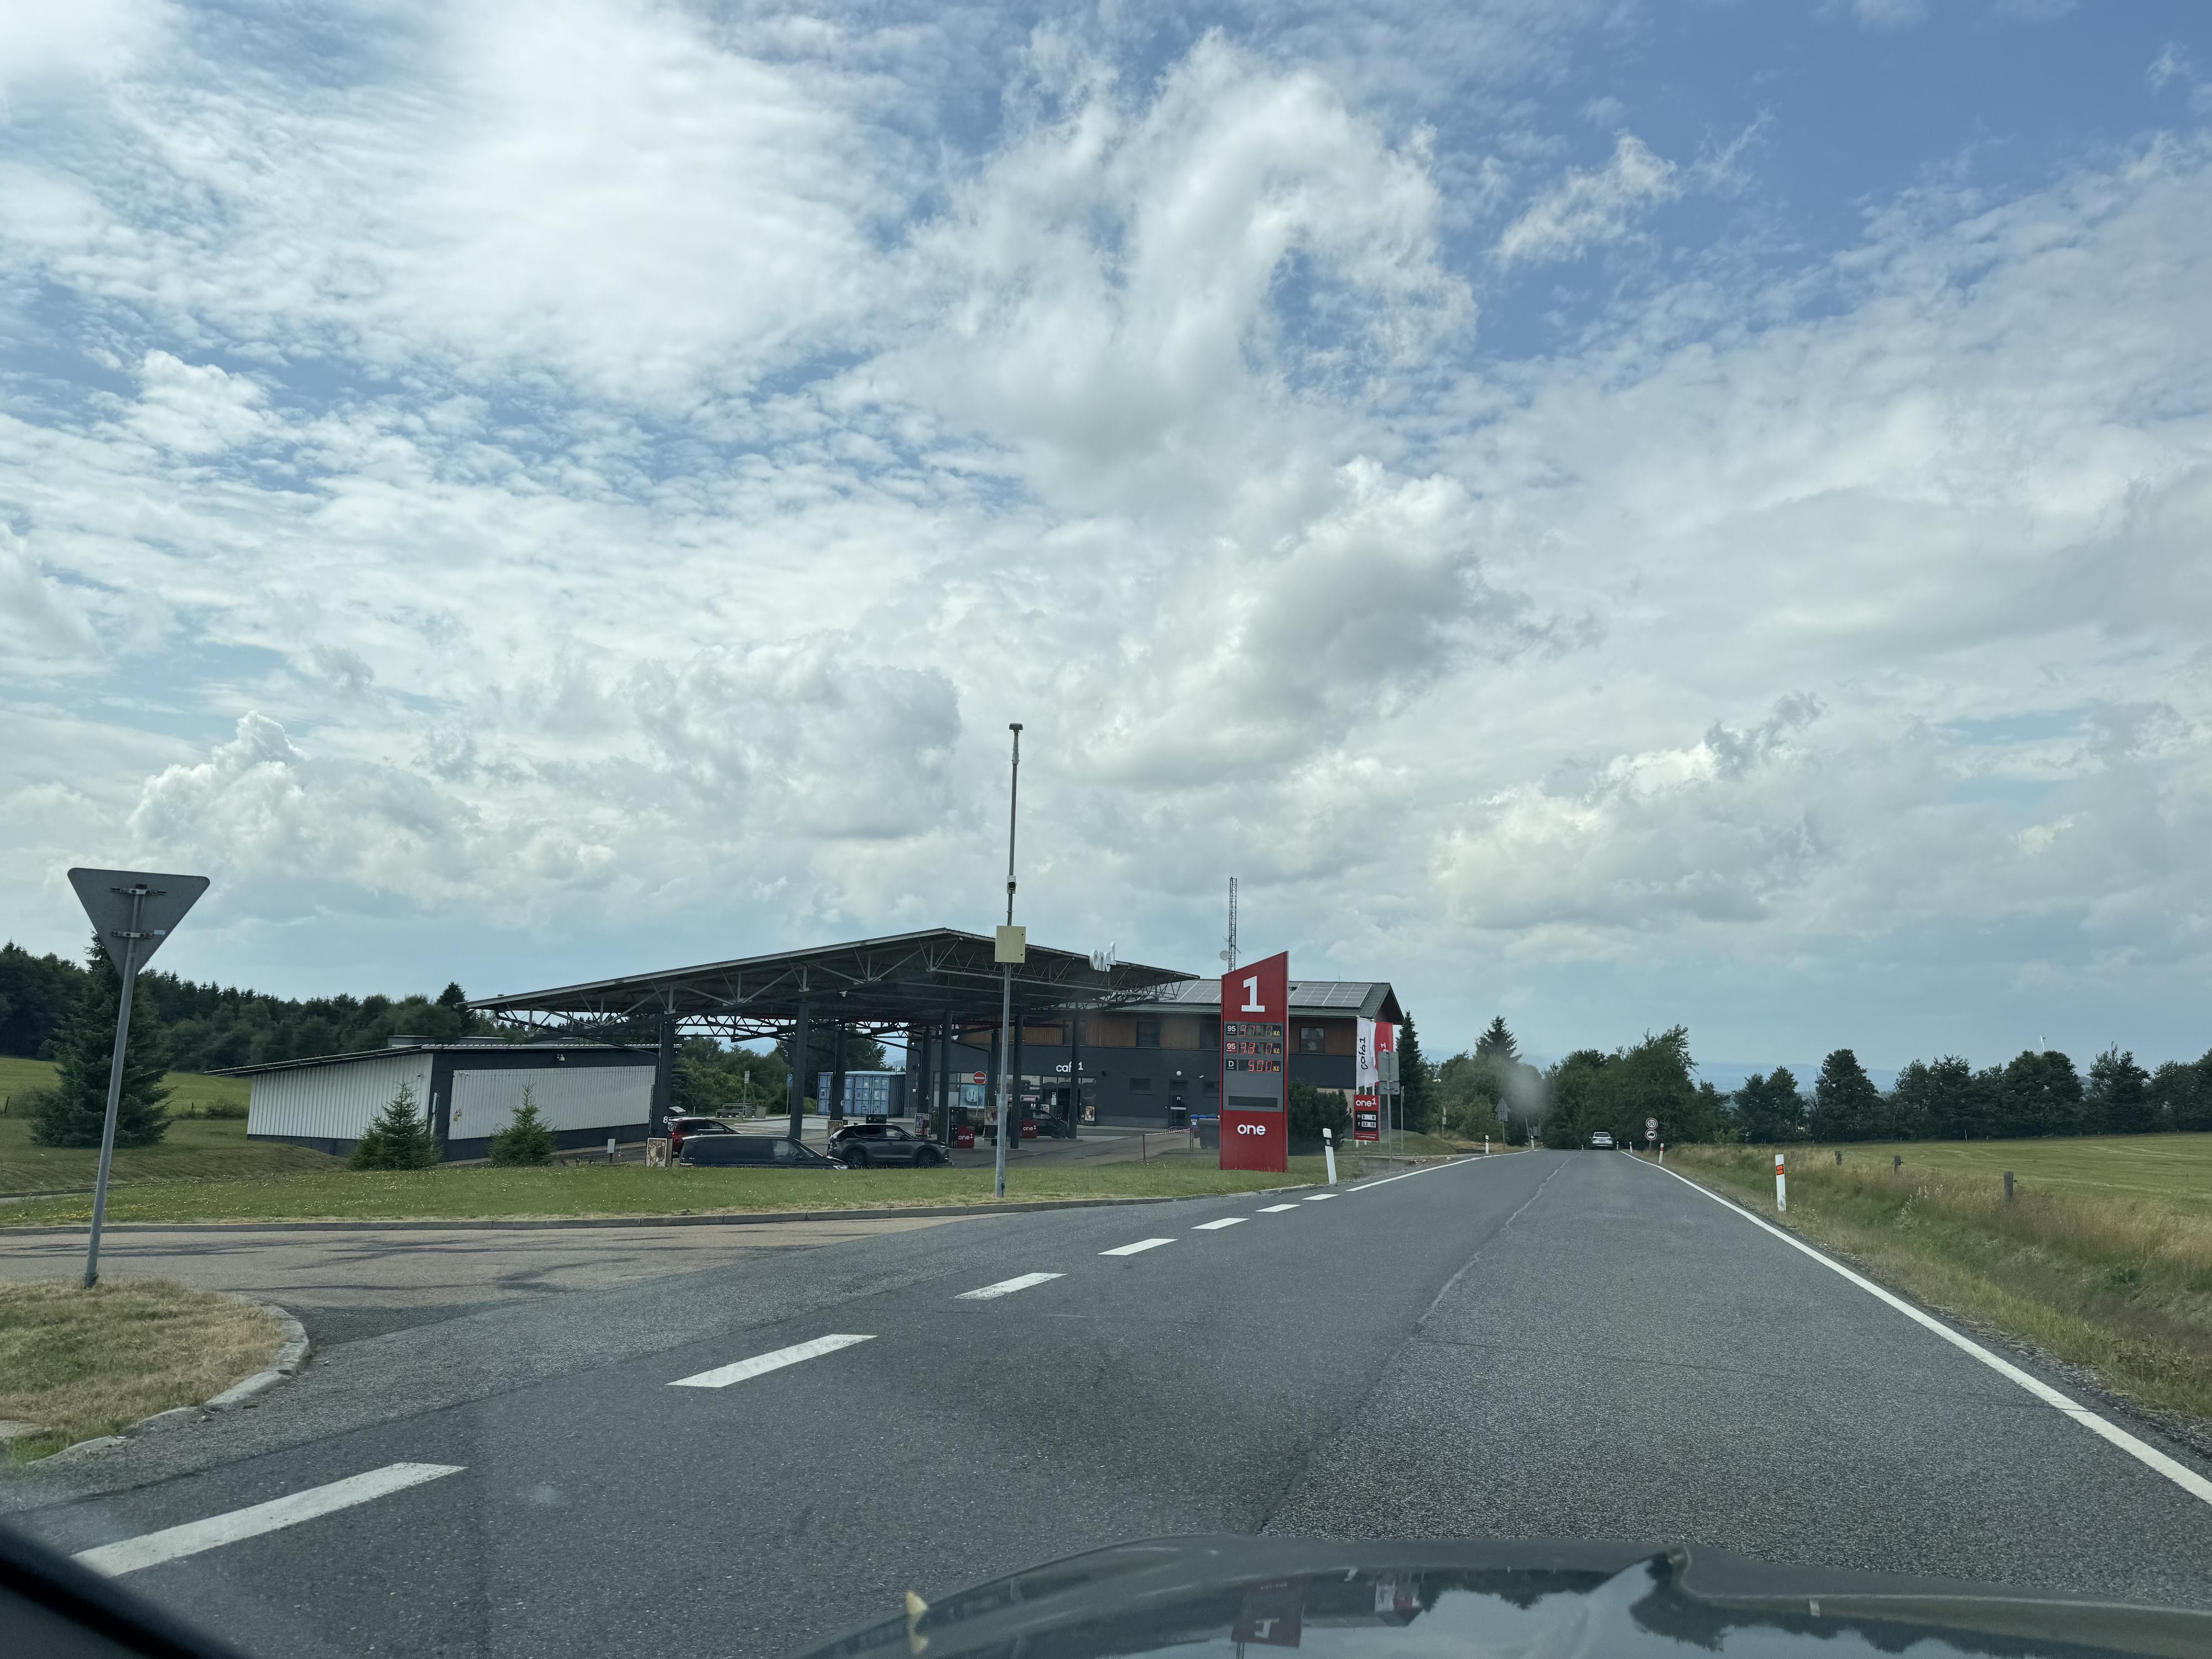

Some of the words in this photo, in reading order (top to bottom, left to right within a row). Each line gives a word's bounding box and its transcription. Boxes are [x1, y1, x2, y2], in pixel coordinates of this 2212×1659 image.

[1241, 975, 1265, 1012] 1
[1056, 1061, 1084, 1072] caf1
[1237, 1124, 1266, 1135] one
